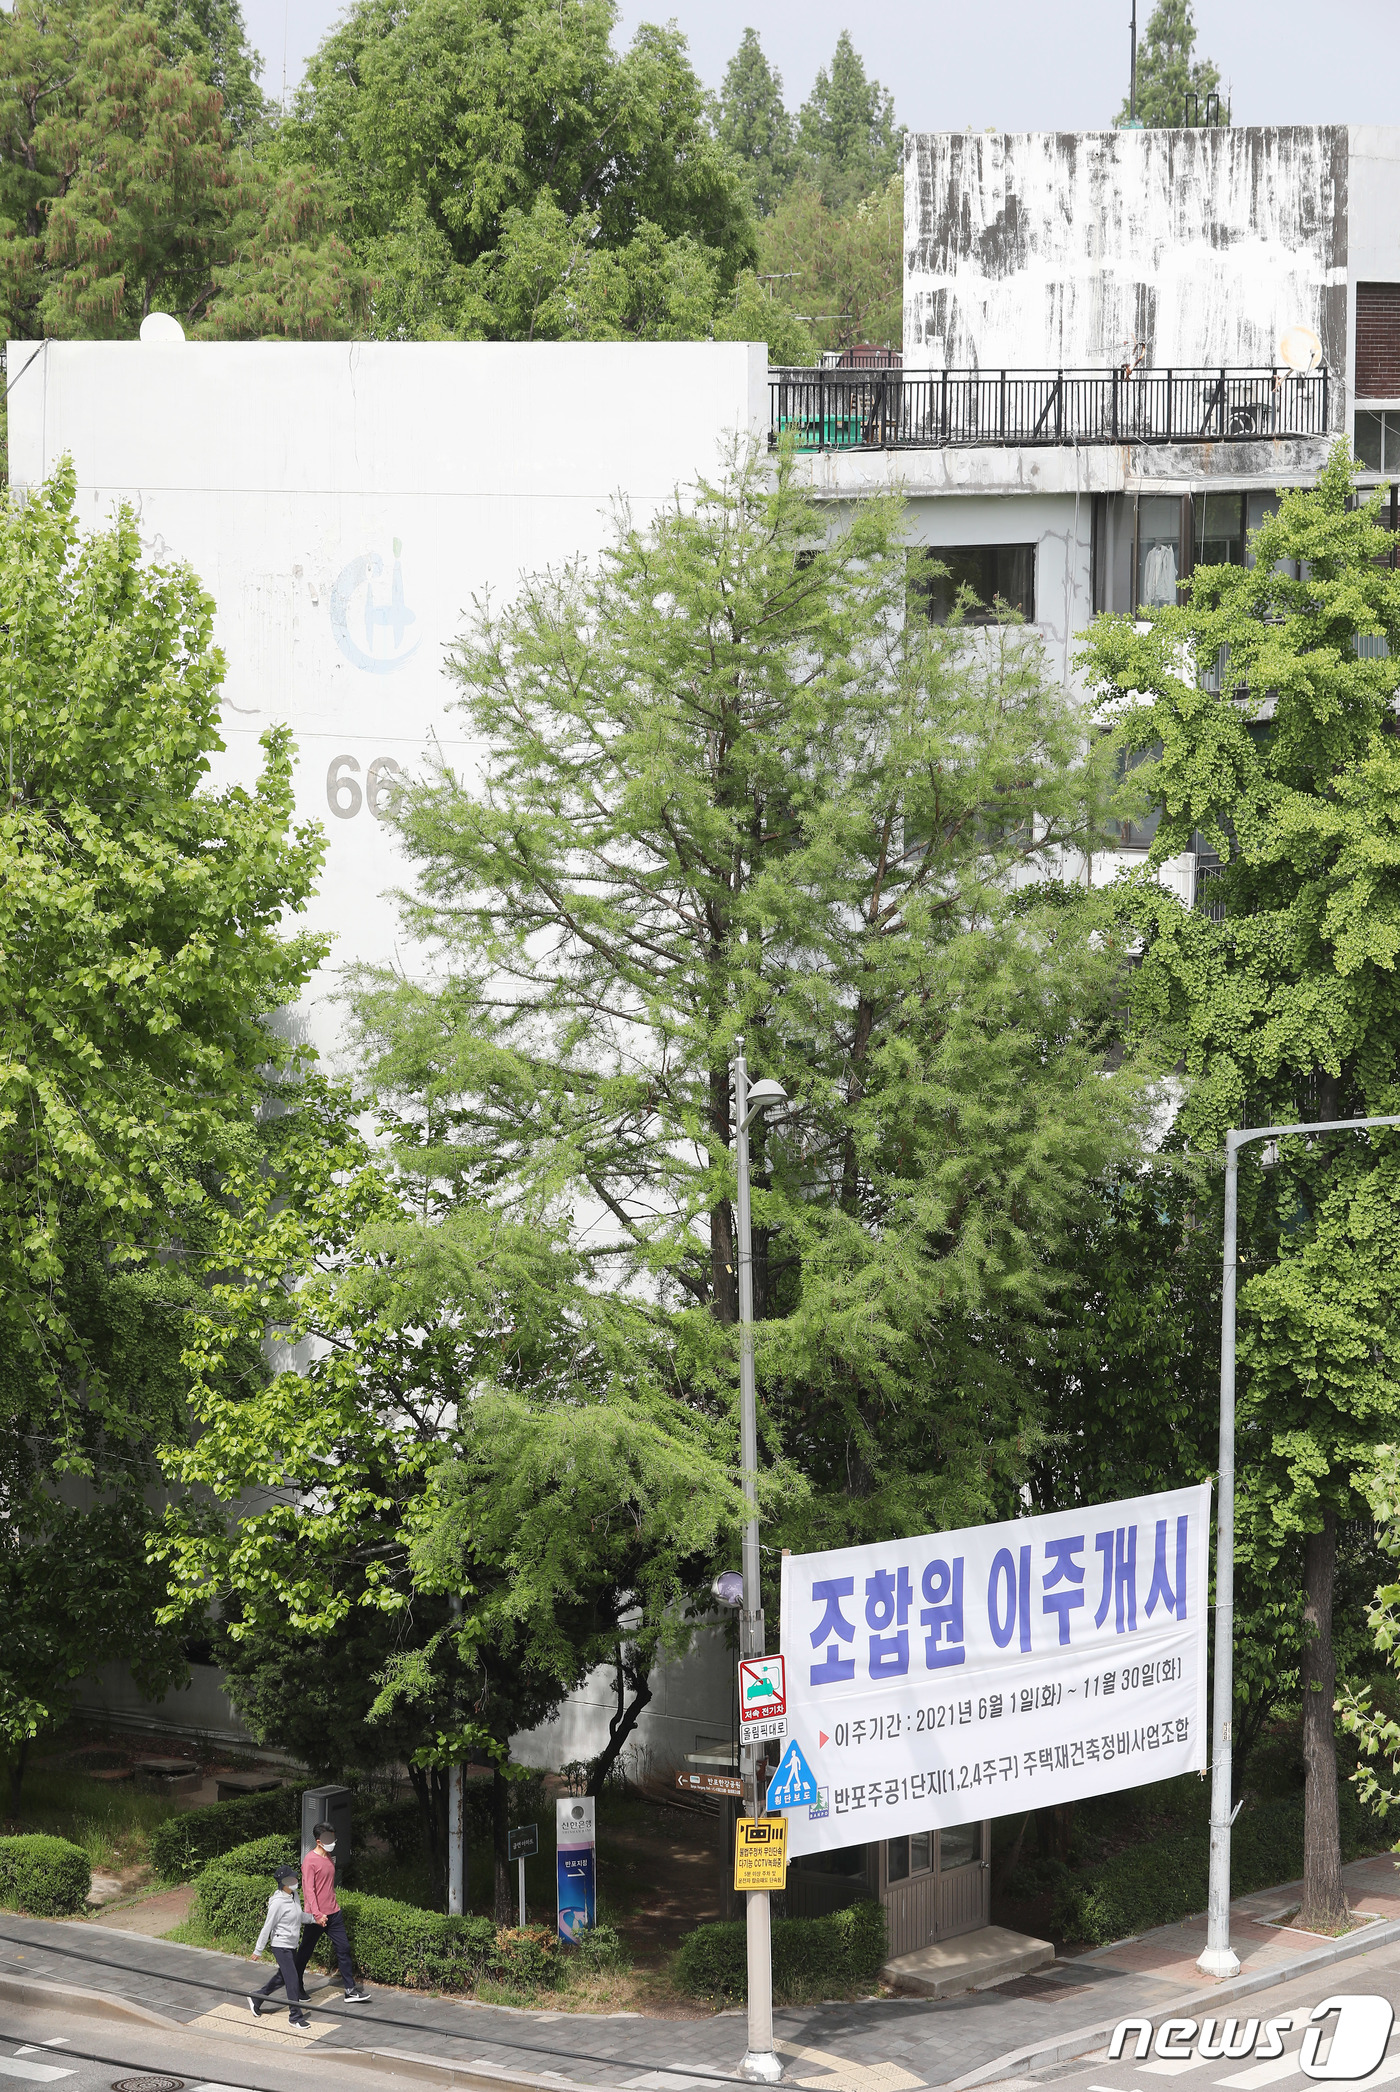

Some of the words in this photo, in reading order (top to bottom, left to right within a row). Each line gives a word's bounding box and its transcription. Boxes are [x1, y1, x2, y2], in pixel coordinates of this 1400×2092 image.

[326, 754, 402, 820] 66
[809, 1556, 966, 1686] 조합원
[987, 1514, 1189, 1654] 이주개시
[835, 1713, 902, 1746] 이주기간
[916, 1700, 972, 1732] 2021년
[978, 1694, 1003, 1720] 6월
[1010, 1683, 1062, 1713] 1일(화)
[1084, 1671, 1116, 1698] 11월
[1121, 1657, 1182, 1691] 30일(화)
[744, 1709, 760, 1719] 저속
[761, 1704, 784, 1716] 전기차
[743, 1721, 785, 1741] 올림픽대로
[834, 1755, 1019, 1814] 반포주공1단지(1,2,4주구)
[1023, 1717, 1189, 1777] 주택재건축정비사업조합
[707, 1777, 741, 1790] 반포한강공원
[774, 1791, 811, 1806] 횡단보도
[561, 1820, 592, 1830] 신한은행
[763, 1846, 782, 1857] 무인단속
[564, 1859, 588, 1868] 반포지점
[738, 1859, 753, 1869] 다기능
